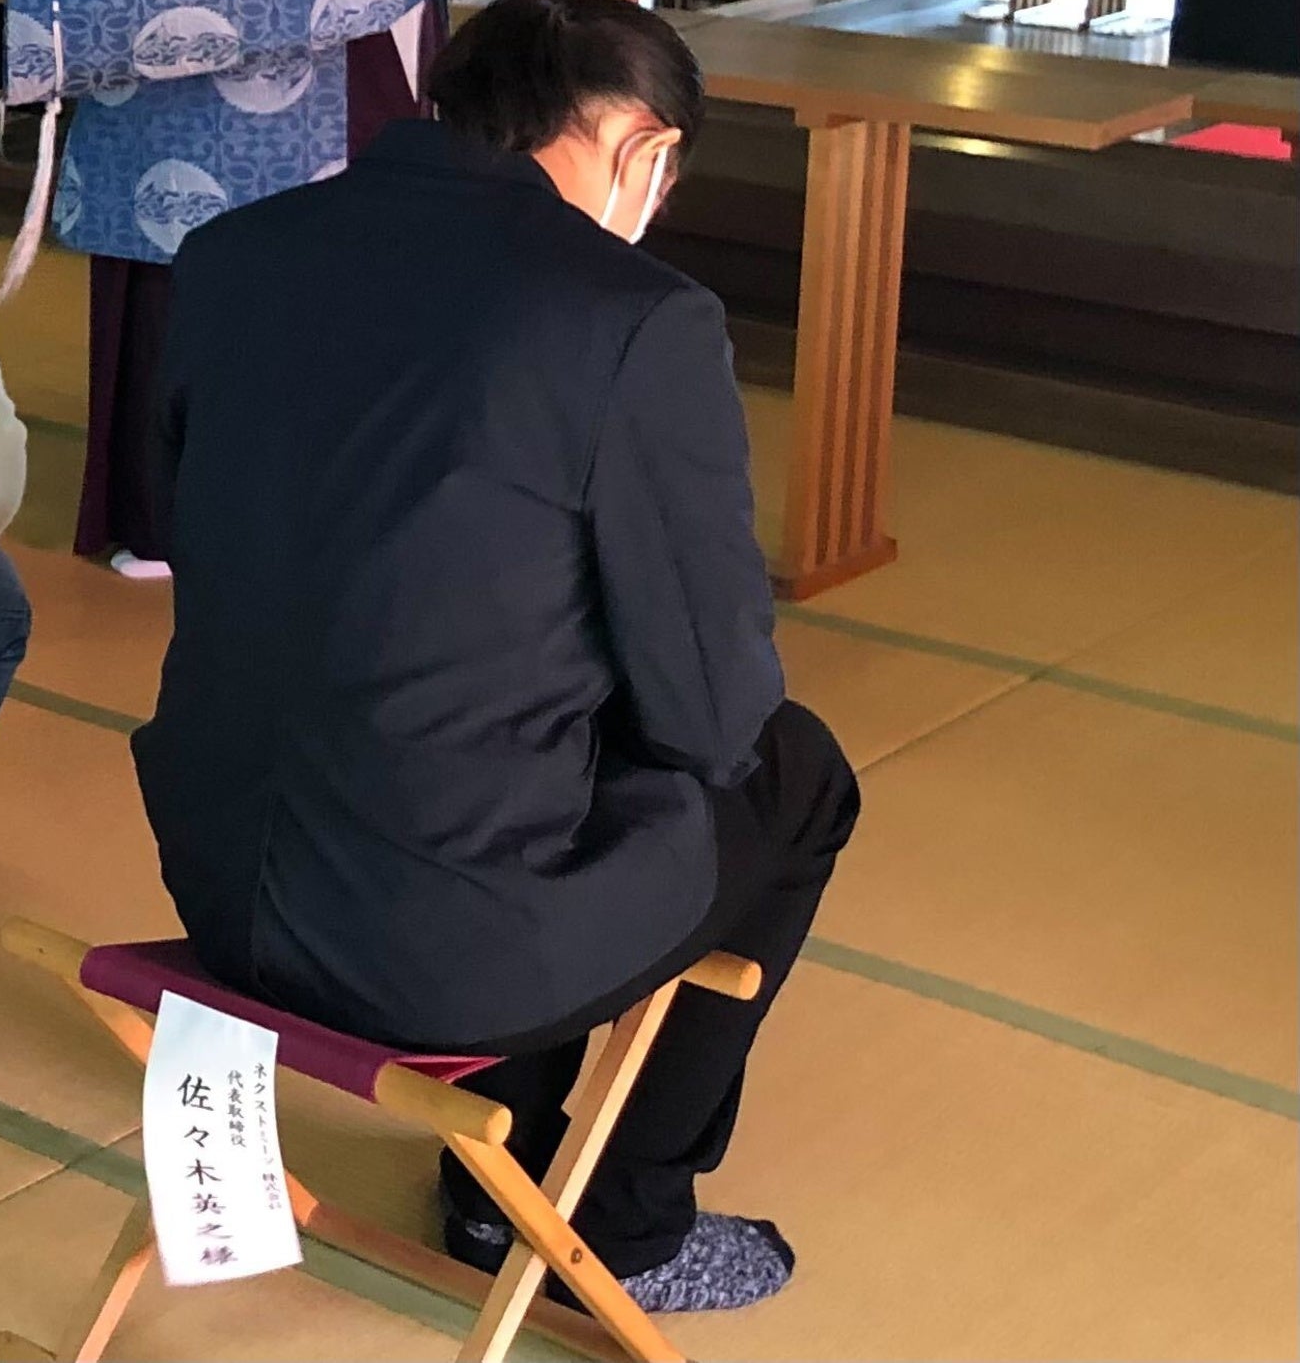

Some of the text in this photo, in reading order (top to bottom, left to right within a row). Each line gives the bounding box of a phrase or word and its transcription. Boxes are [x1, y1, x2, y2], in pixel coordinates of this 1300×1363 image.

[226, 1068, 248, 1149] 代表取締役
